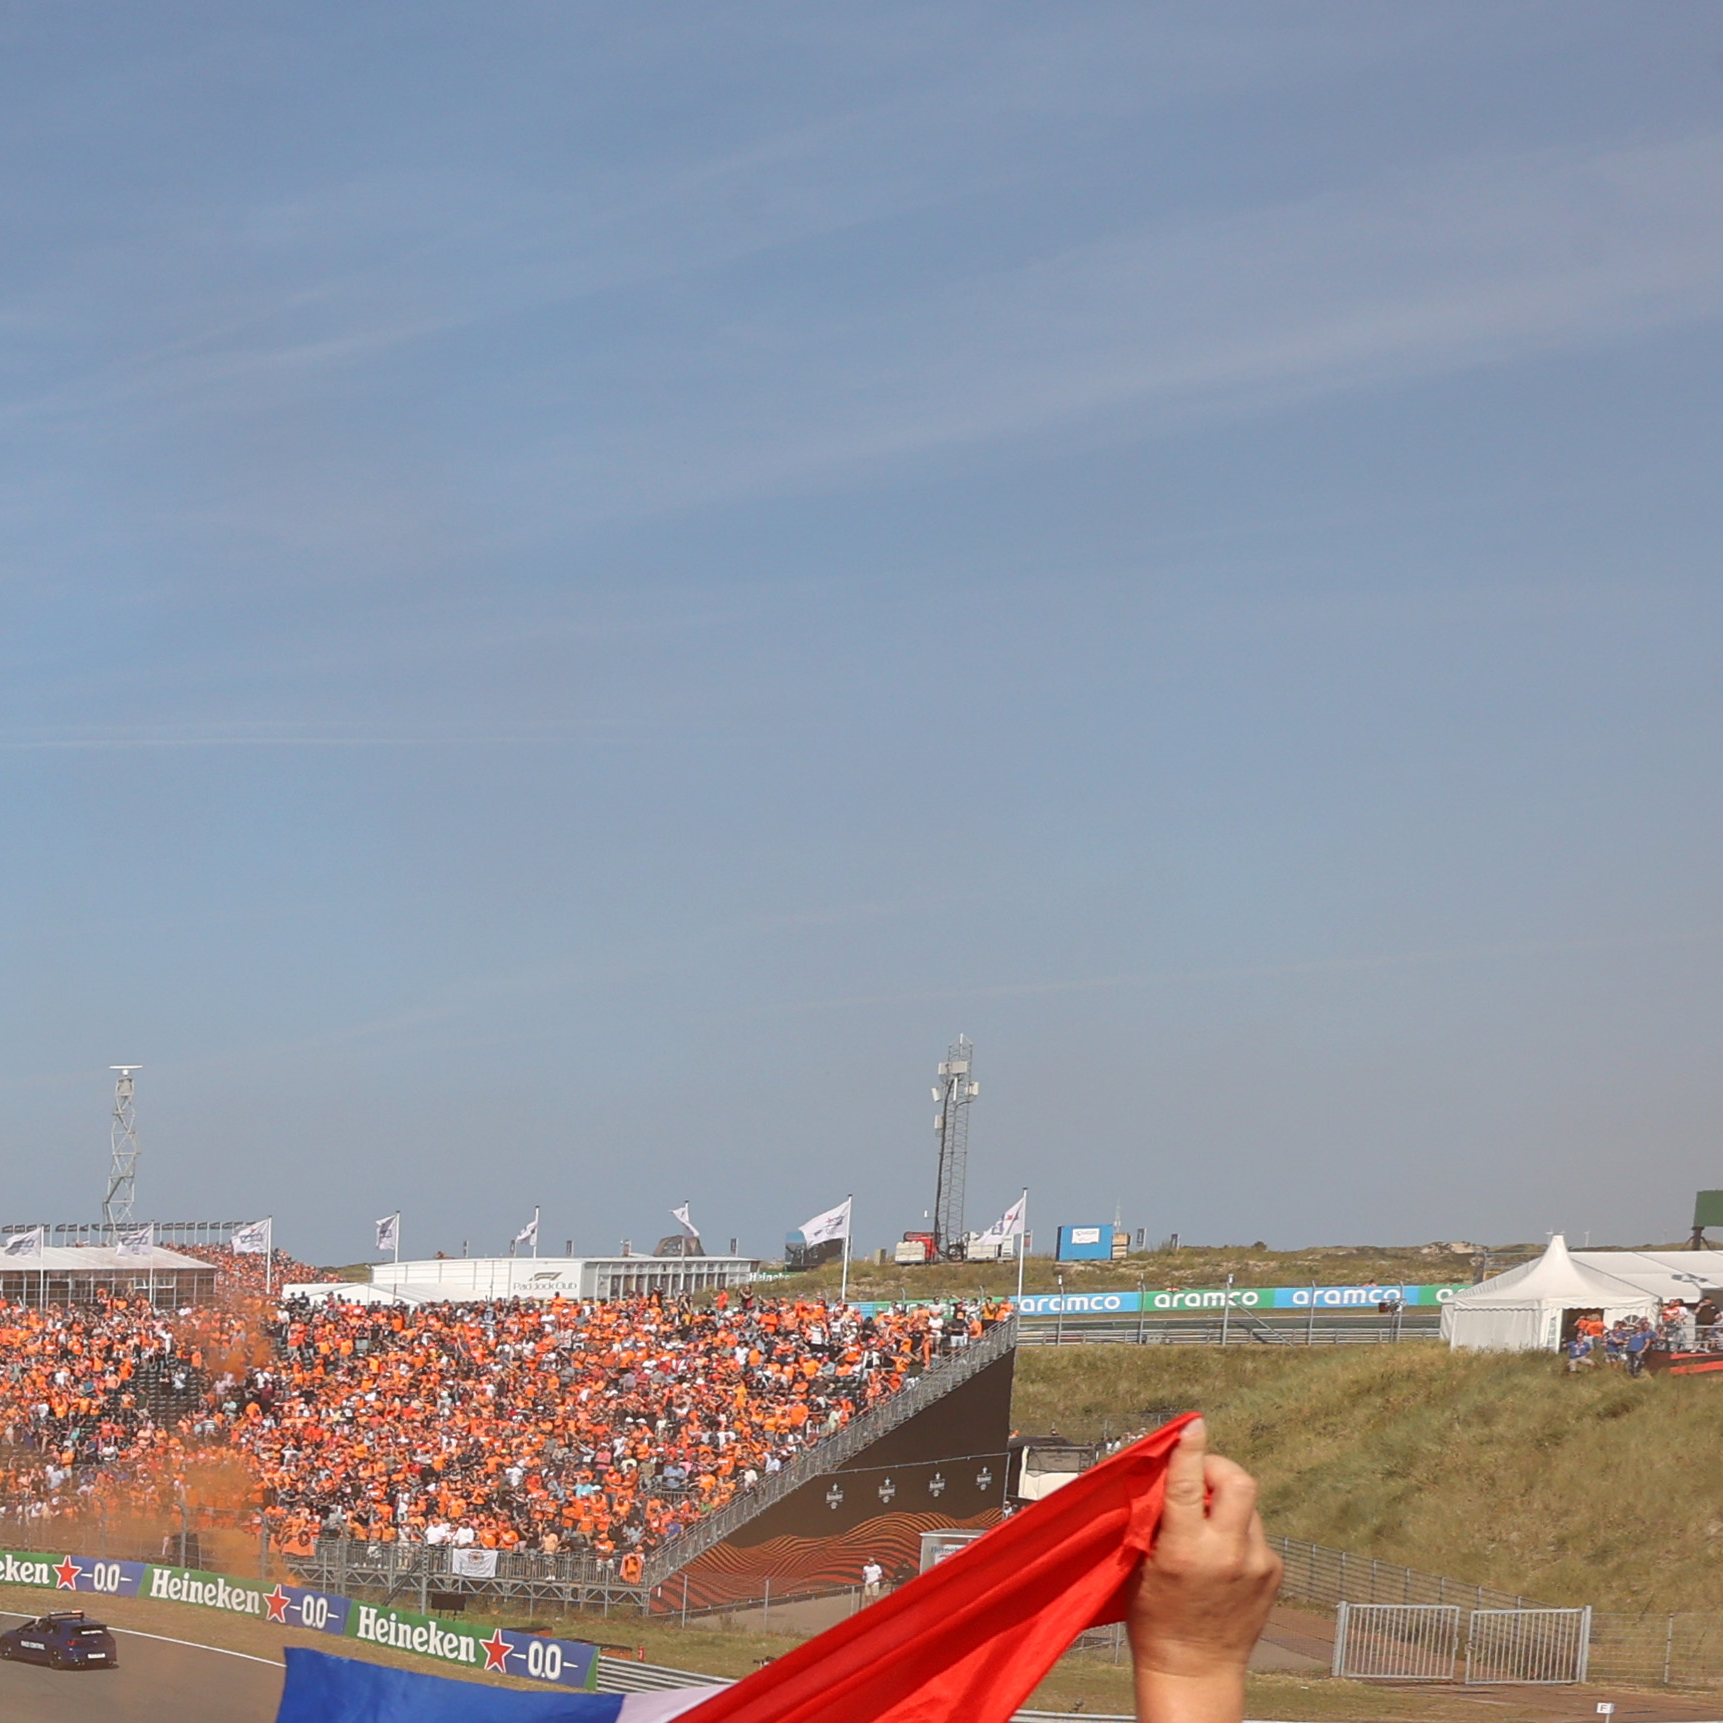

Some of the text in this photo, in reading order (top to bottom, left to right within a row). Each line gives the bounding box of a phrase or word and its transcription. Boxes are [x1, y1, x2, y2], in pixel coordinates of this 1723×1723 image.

[1020, 1295, 1121, 1313] aramco
[1155, 1290, 1259, 1308] aramco
[1292, 1288, 1402, 1306] aramco
[150, 1568, 261, 1614] Heineken
[356, 1605, 477, 1663] Heineken
